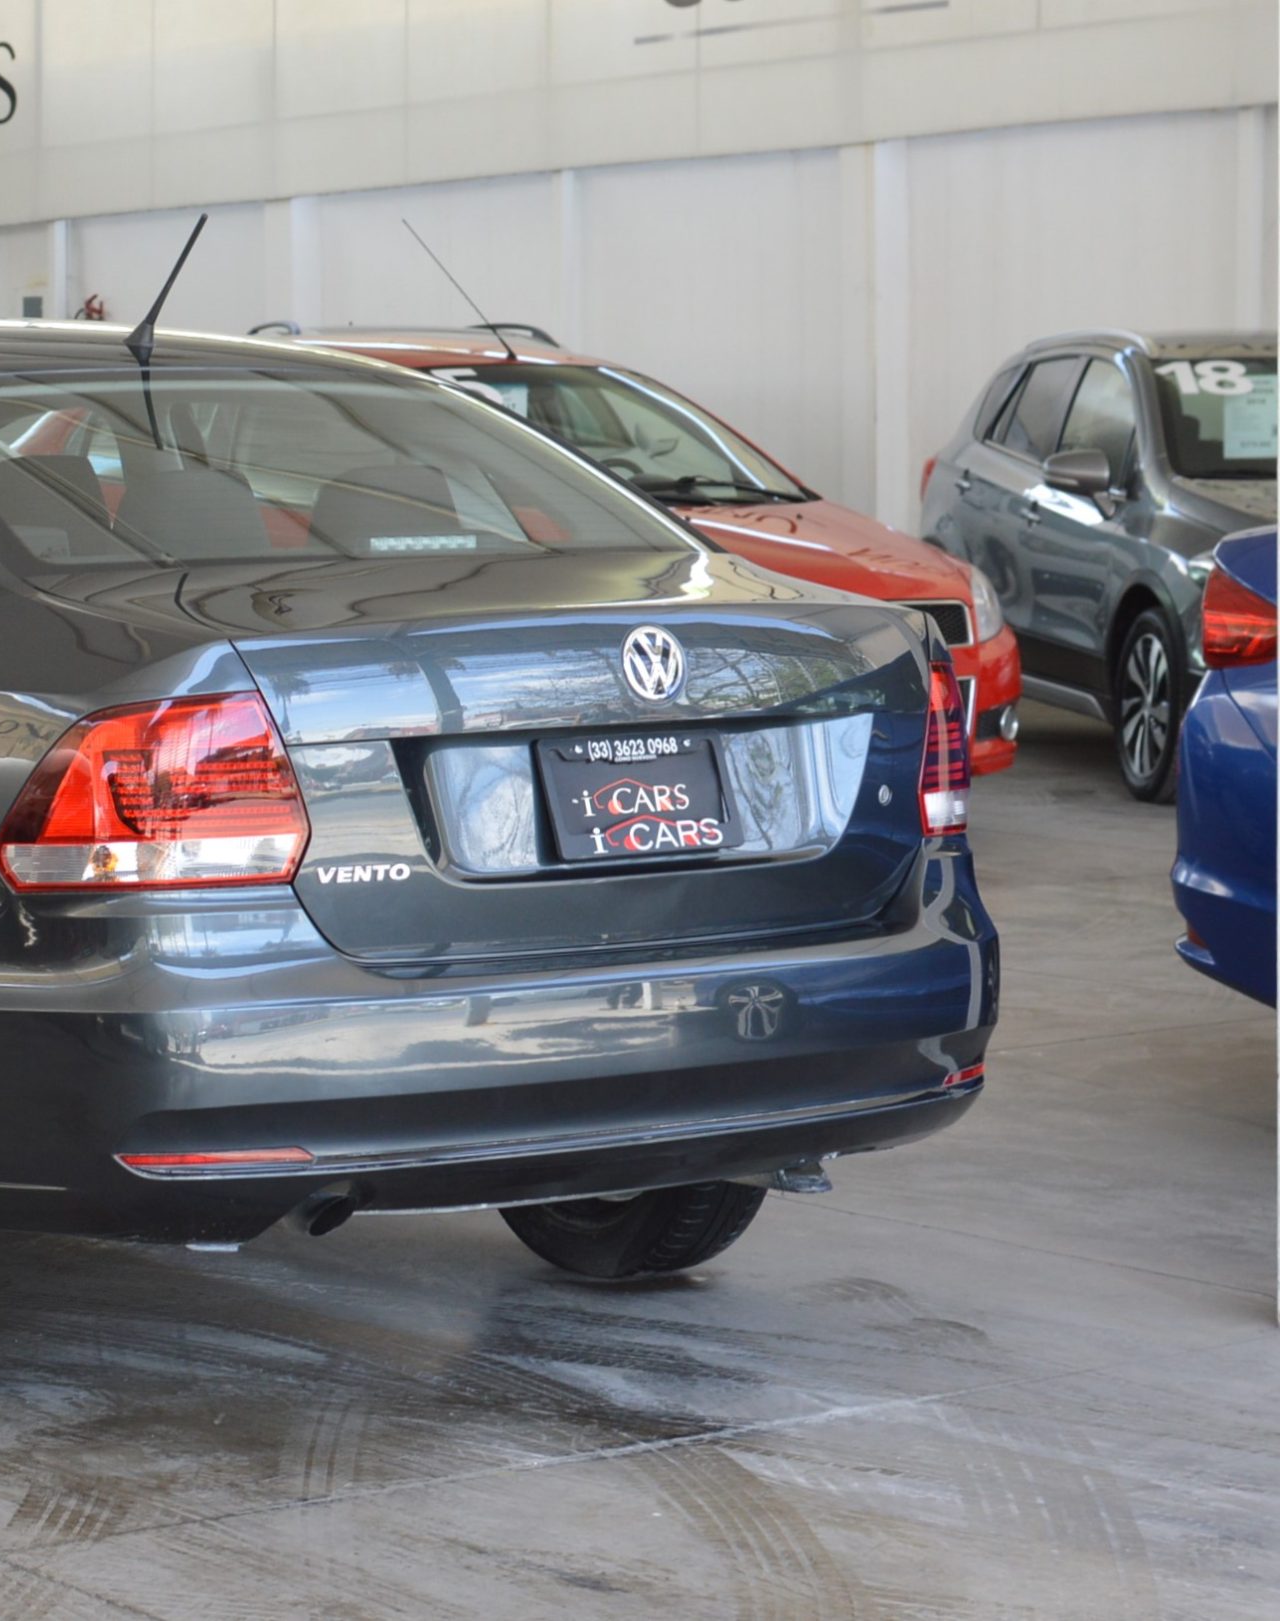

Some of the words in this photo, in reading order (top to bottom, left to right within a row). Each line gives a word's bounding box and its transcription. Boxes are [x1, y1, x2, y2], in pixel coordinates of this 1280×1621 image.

[1154, 360, 1254, 395] 18
[587, 739, 613, 761] (33)
[614, 739, 645, 756] 3623
[647, 736, 678, 755] 0968
[580, 790, 596, 817] i
[612, 783, 690, 814] CARS
[589, 827, 608, 854] i
[628, 818, 724, 850] CARS
[317, 863, 411, 884] VENTO
